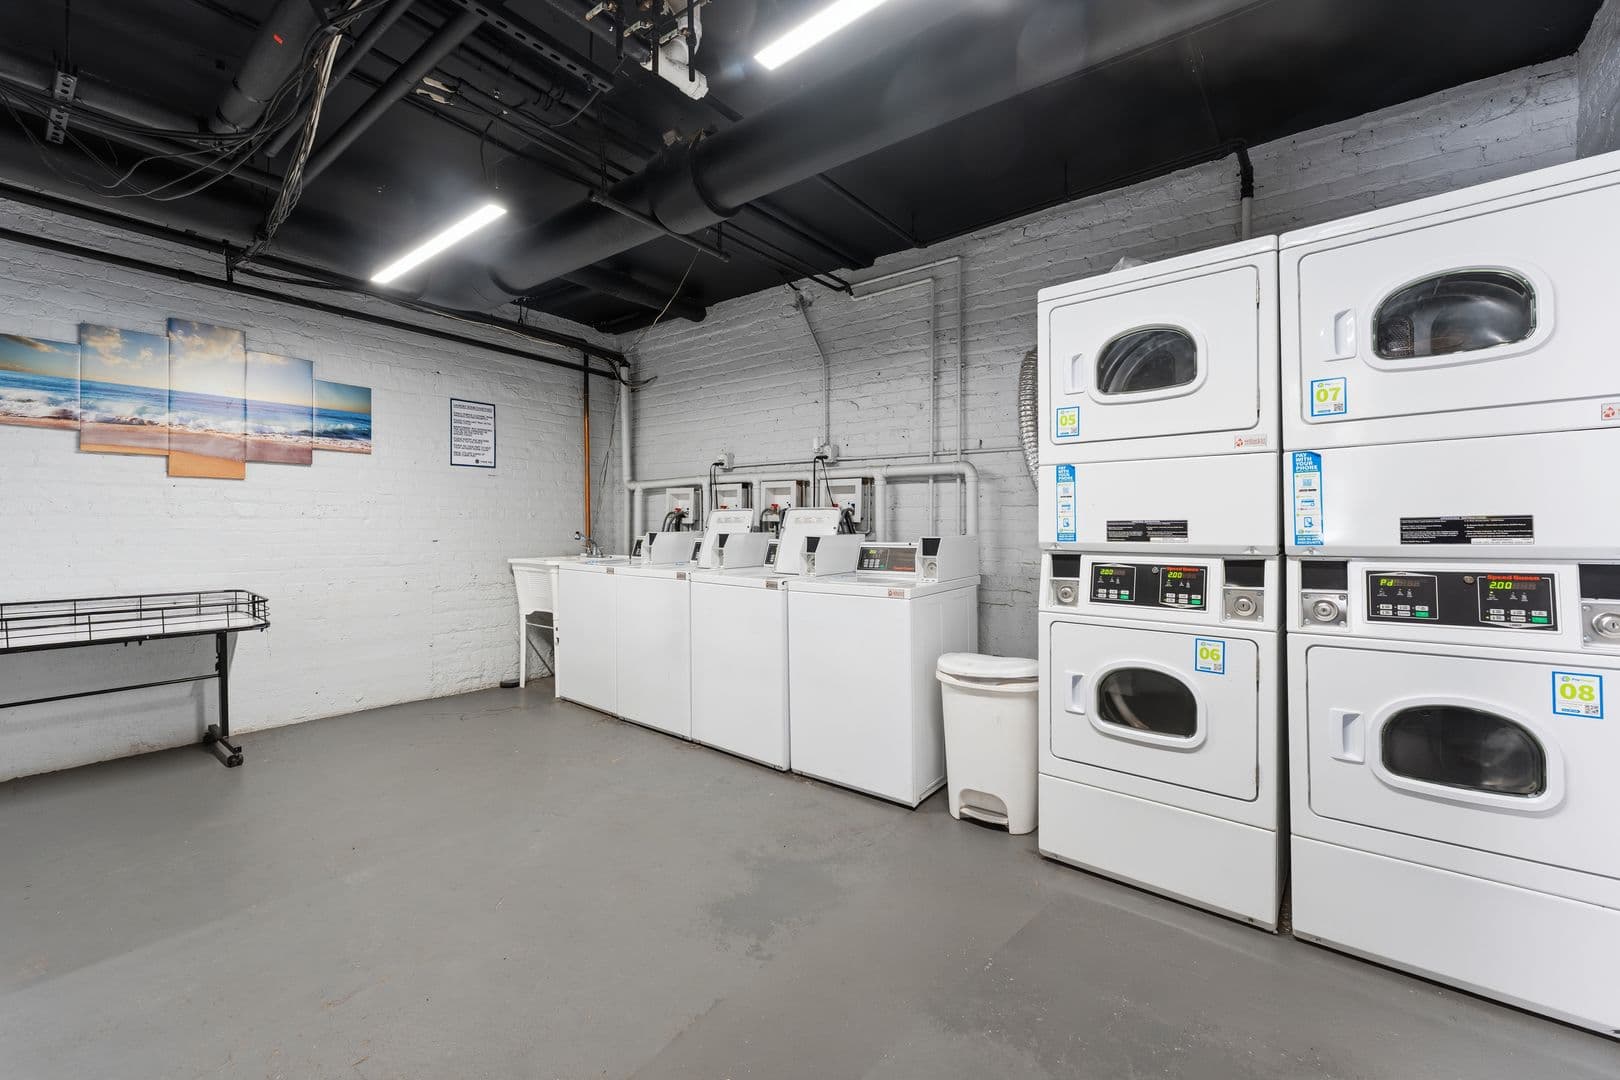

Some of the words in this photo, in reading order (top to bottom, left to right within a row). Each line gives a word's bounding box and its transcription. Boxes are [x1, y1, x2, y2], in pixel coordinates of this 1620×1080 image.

[1316, 387, 1341, 402] 07
[1060, 415, 1076, 426] 05
[1380, 578, 1394, 587] Pd
[1199, 647, 1220, 661] 06
[1560, 683, 1595, 702] 08
